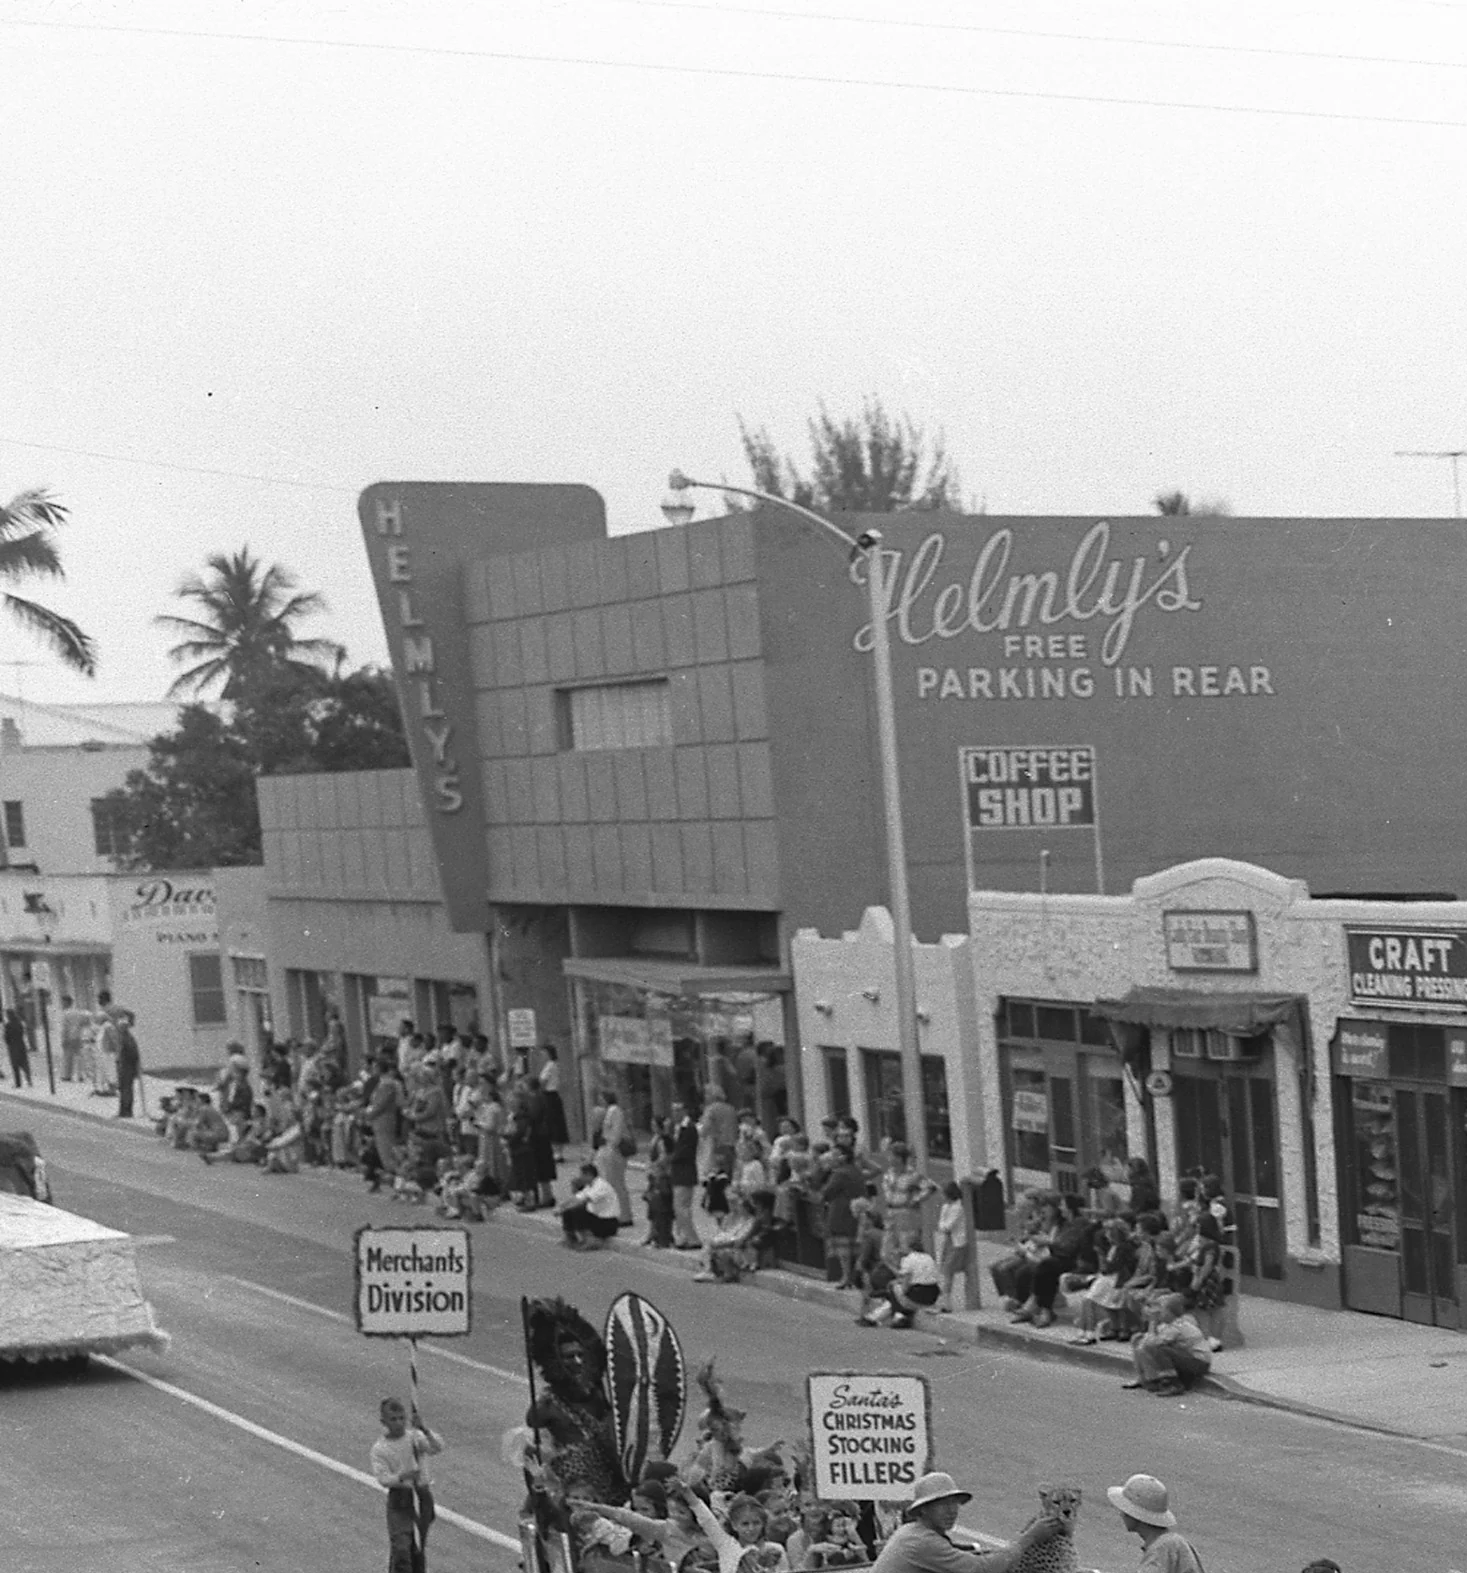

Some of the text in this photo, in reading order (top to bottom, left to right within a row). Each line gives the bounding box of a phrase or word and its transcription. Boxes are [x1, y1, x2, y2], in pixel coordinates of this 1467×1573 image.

[849, 522, 1202, 665] Helmly's
[1004, 635, 1088, 659] FREE
[917, 665, 1275, 699] PARKING IN REAR
[968, 750, 1093, 783] COFFEE
[979, 788, 1084, 826] SHOP
[1368, 936, 1453, 972] CRAFT
[1353, 972, 1412, 997] CLEANING
[366, 1243, 464, 1275] Merchants
[367, 1281, 464, 1314] Division
[829, 1384, 904, 1410] Santa's
[822, 1411, 917, 1432] CHRISTMAS
[828, 1435, 916, 1455] STOCKING
[829, 1461, 915, 1486] FILLERS
